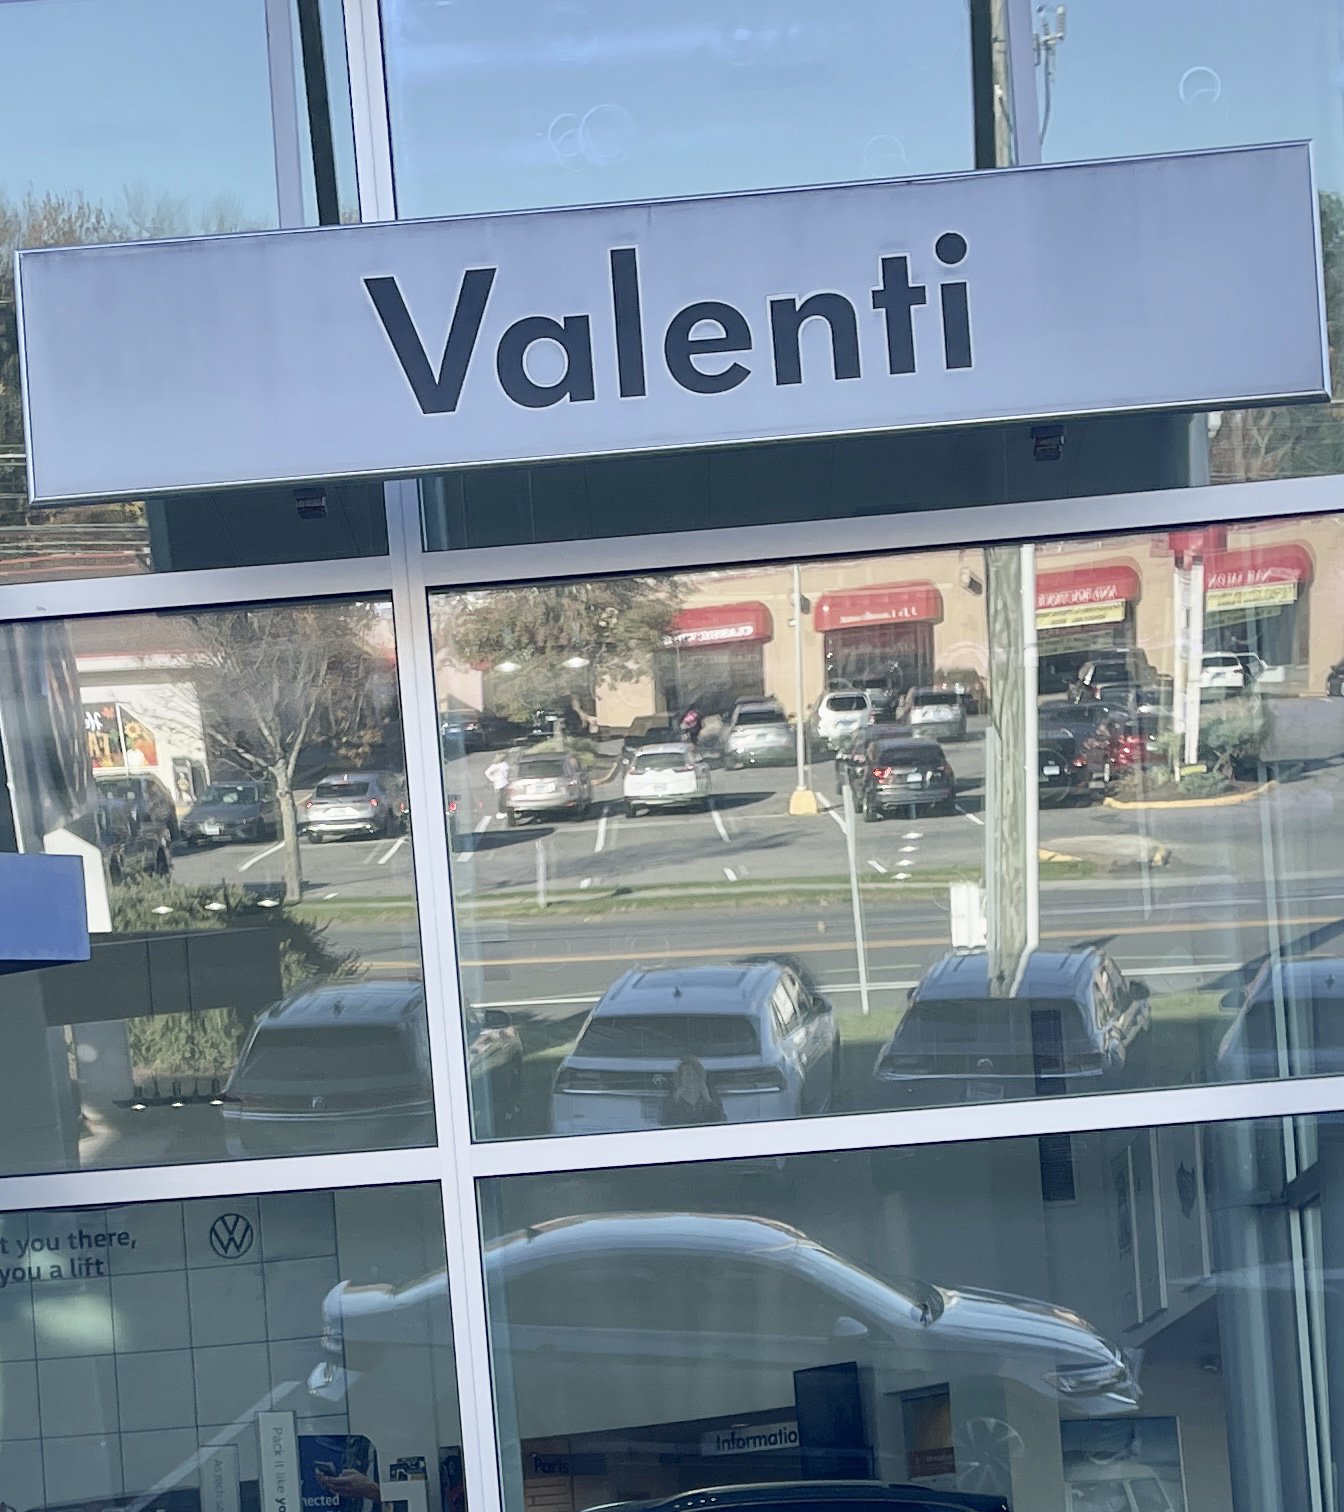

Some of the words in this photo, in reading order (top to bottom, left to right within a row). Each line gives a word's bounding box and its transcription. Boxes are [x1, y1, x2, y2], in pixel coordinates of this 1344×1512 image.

[362, 231, 973, 416] Valenti
[16, 1235, 60, 1258] you
[68, 1228, 137, 1250] there,
[50, 1262, 63, 1279] a
[70, 1258, 105, 1279] lift
[272, 1427, 284, 1456] Pack
[716, 1427, 798, 1451] Informatio
[276, 1473, 287, 1494] like
[303, 1493, 340, 1506] nected
